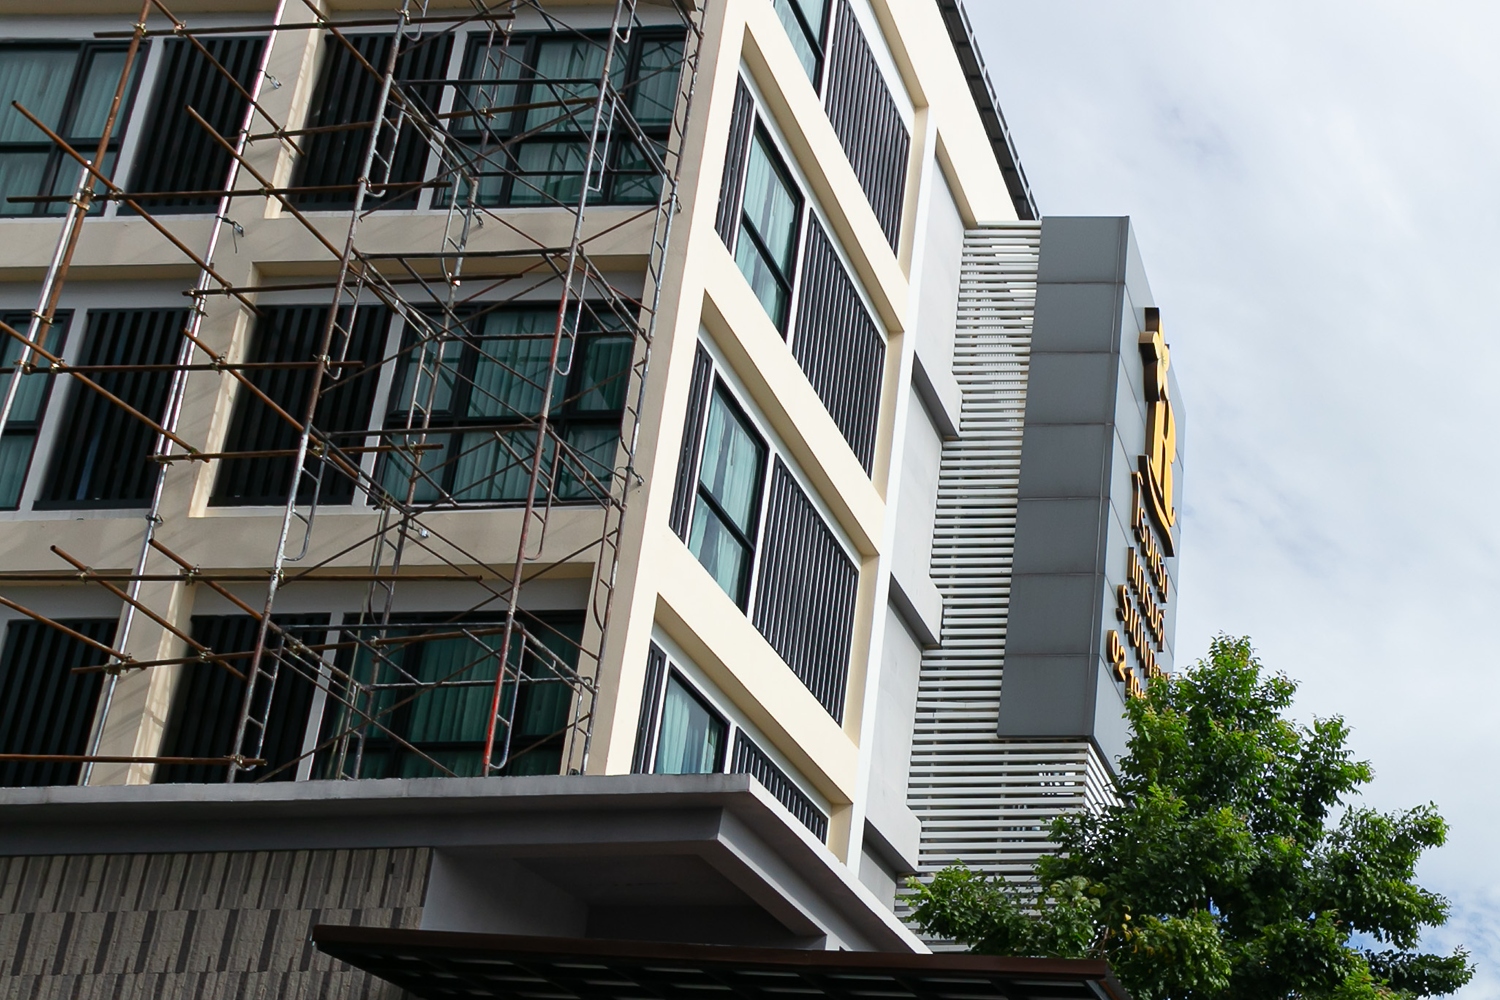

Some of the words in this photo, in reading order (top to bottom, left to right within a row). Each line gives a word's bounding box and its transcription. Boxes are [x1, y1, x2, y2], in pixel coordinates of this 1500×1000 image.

[1131, 471, 1168, 604] โรงแรม
[1106, 629, 1126, 682] 02
